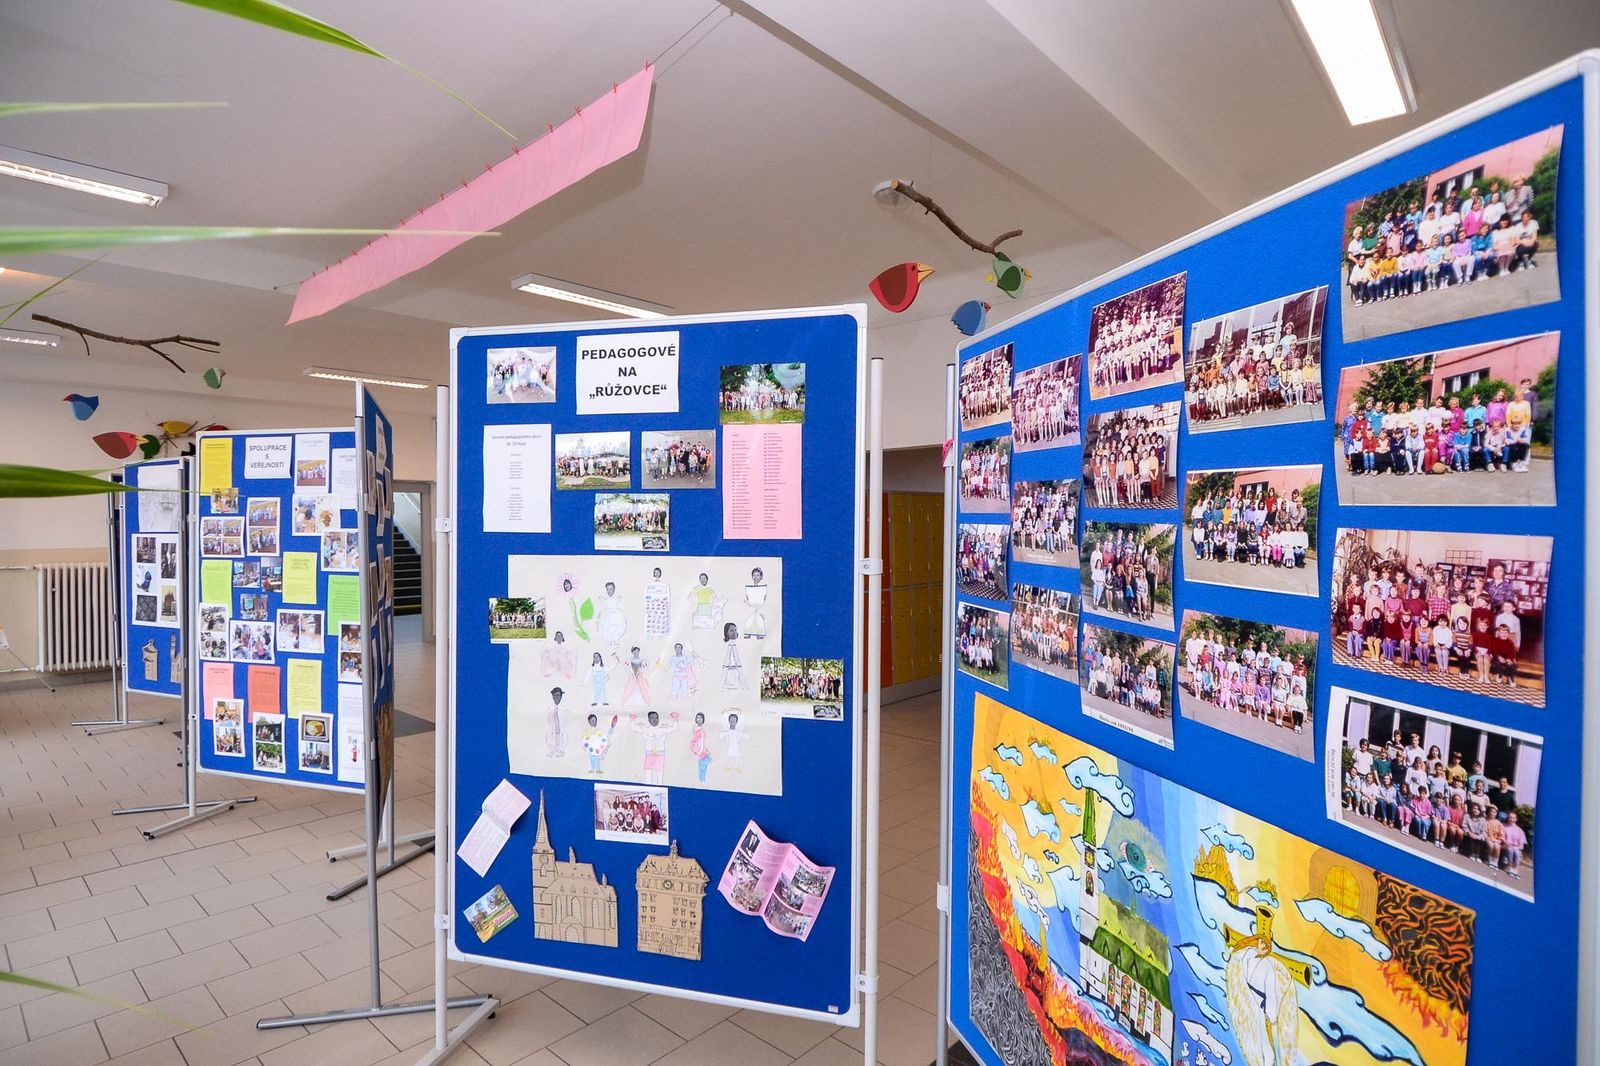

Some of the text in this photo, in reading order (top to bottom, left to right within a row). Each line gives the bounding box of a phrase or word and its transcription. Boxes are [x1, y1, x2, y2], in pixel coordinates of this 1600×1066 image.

[581, 343, 677, 360] PEDAGOGOVÉ
[618, 366, 637, 377] NA
[589, 382, 667, 400] „RŮŽOVCE“
